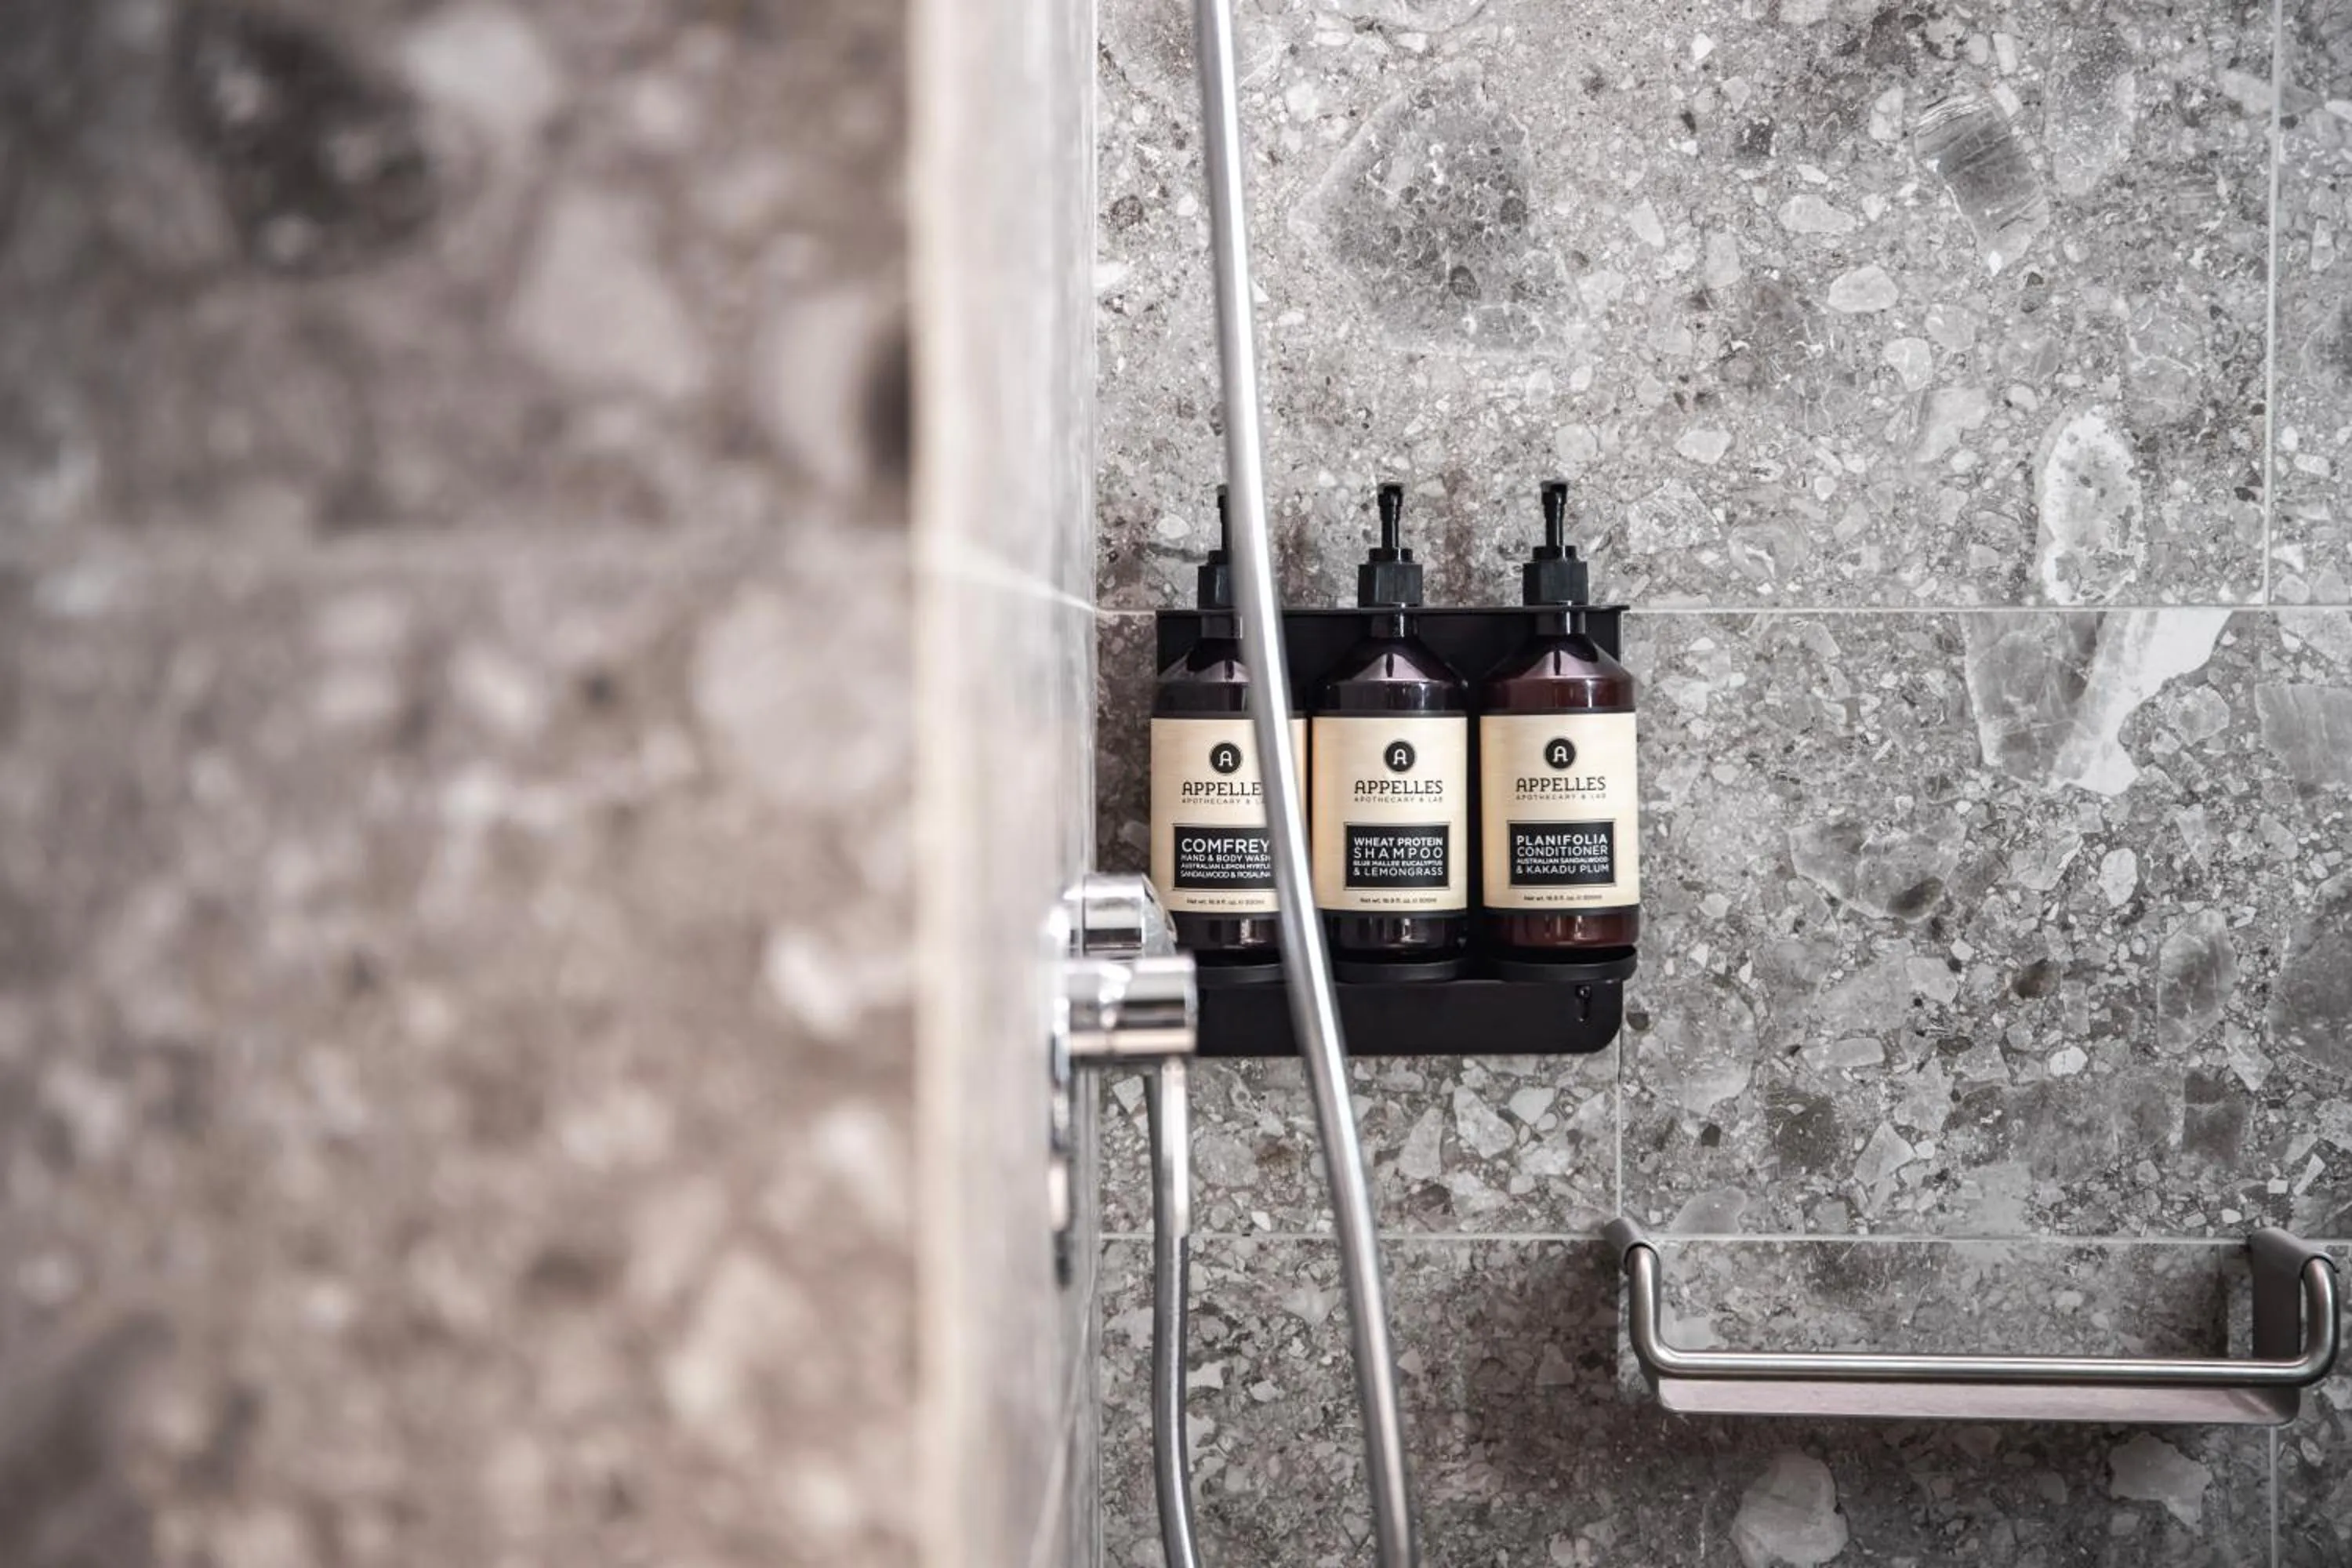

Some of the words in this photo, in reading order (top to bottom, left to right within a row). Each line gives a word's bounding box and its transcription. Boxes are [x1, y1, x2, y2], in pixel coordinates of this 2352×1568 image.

[1218, 750, 1233, 767] A
[1393, 749, 1407, 765] A
[1552, 746, 1568, 763] A
[1181, 782, 1262, 796] APPELLE
[1354, 780, 1443, 794] APPELLES
[1515, 776, 1606, 792] APPELLES
[1181, 838, 1269, 854] COMFREY
[1354, 837, 1395, 847] WHEAT
[1397, 837, 1443, 847] PROTEIN
[1516, 833, 1608, 846] PLANIFOLIA
[1354, 847, 1443, 858] SHAMPOO
[1517, 844, 1608, 857] CONDITIONER
[1181, 854, 1206, 862] HAND
[1353, 867, 1360, 876] &
[1364, 866, 1443, 877] LEMONGRASS
[1516, 866, 1523, 874] &
[1526, 865, 1577, 874] KAKADU
[1580, 863, 1610, 873] PLUM
